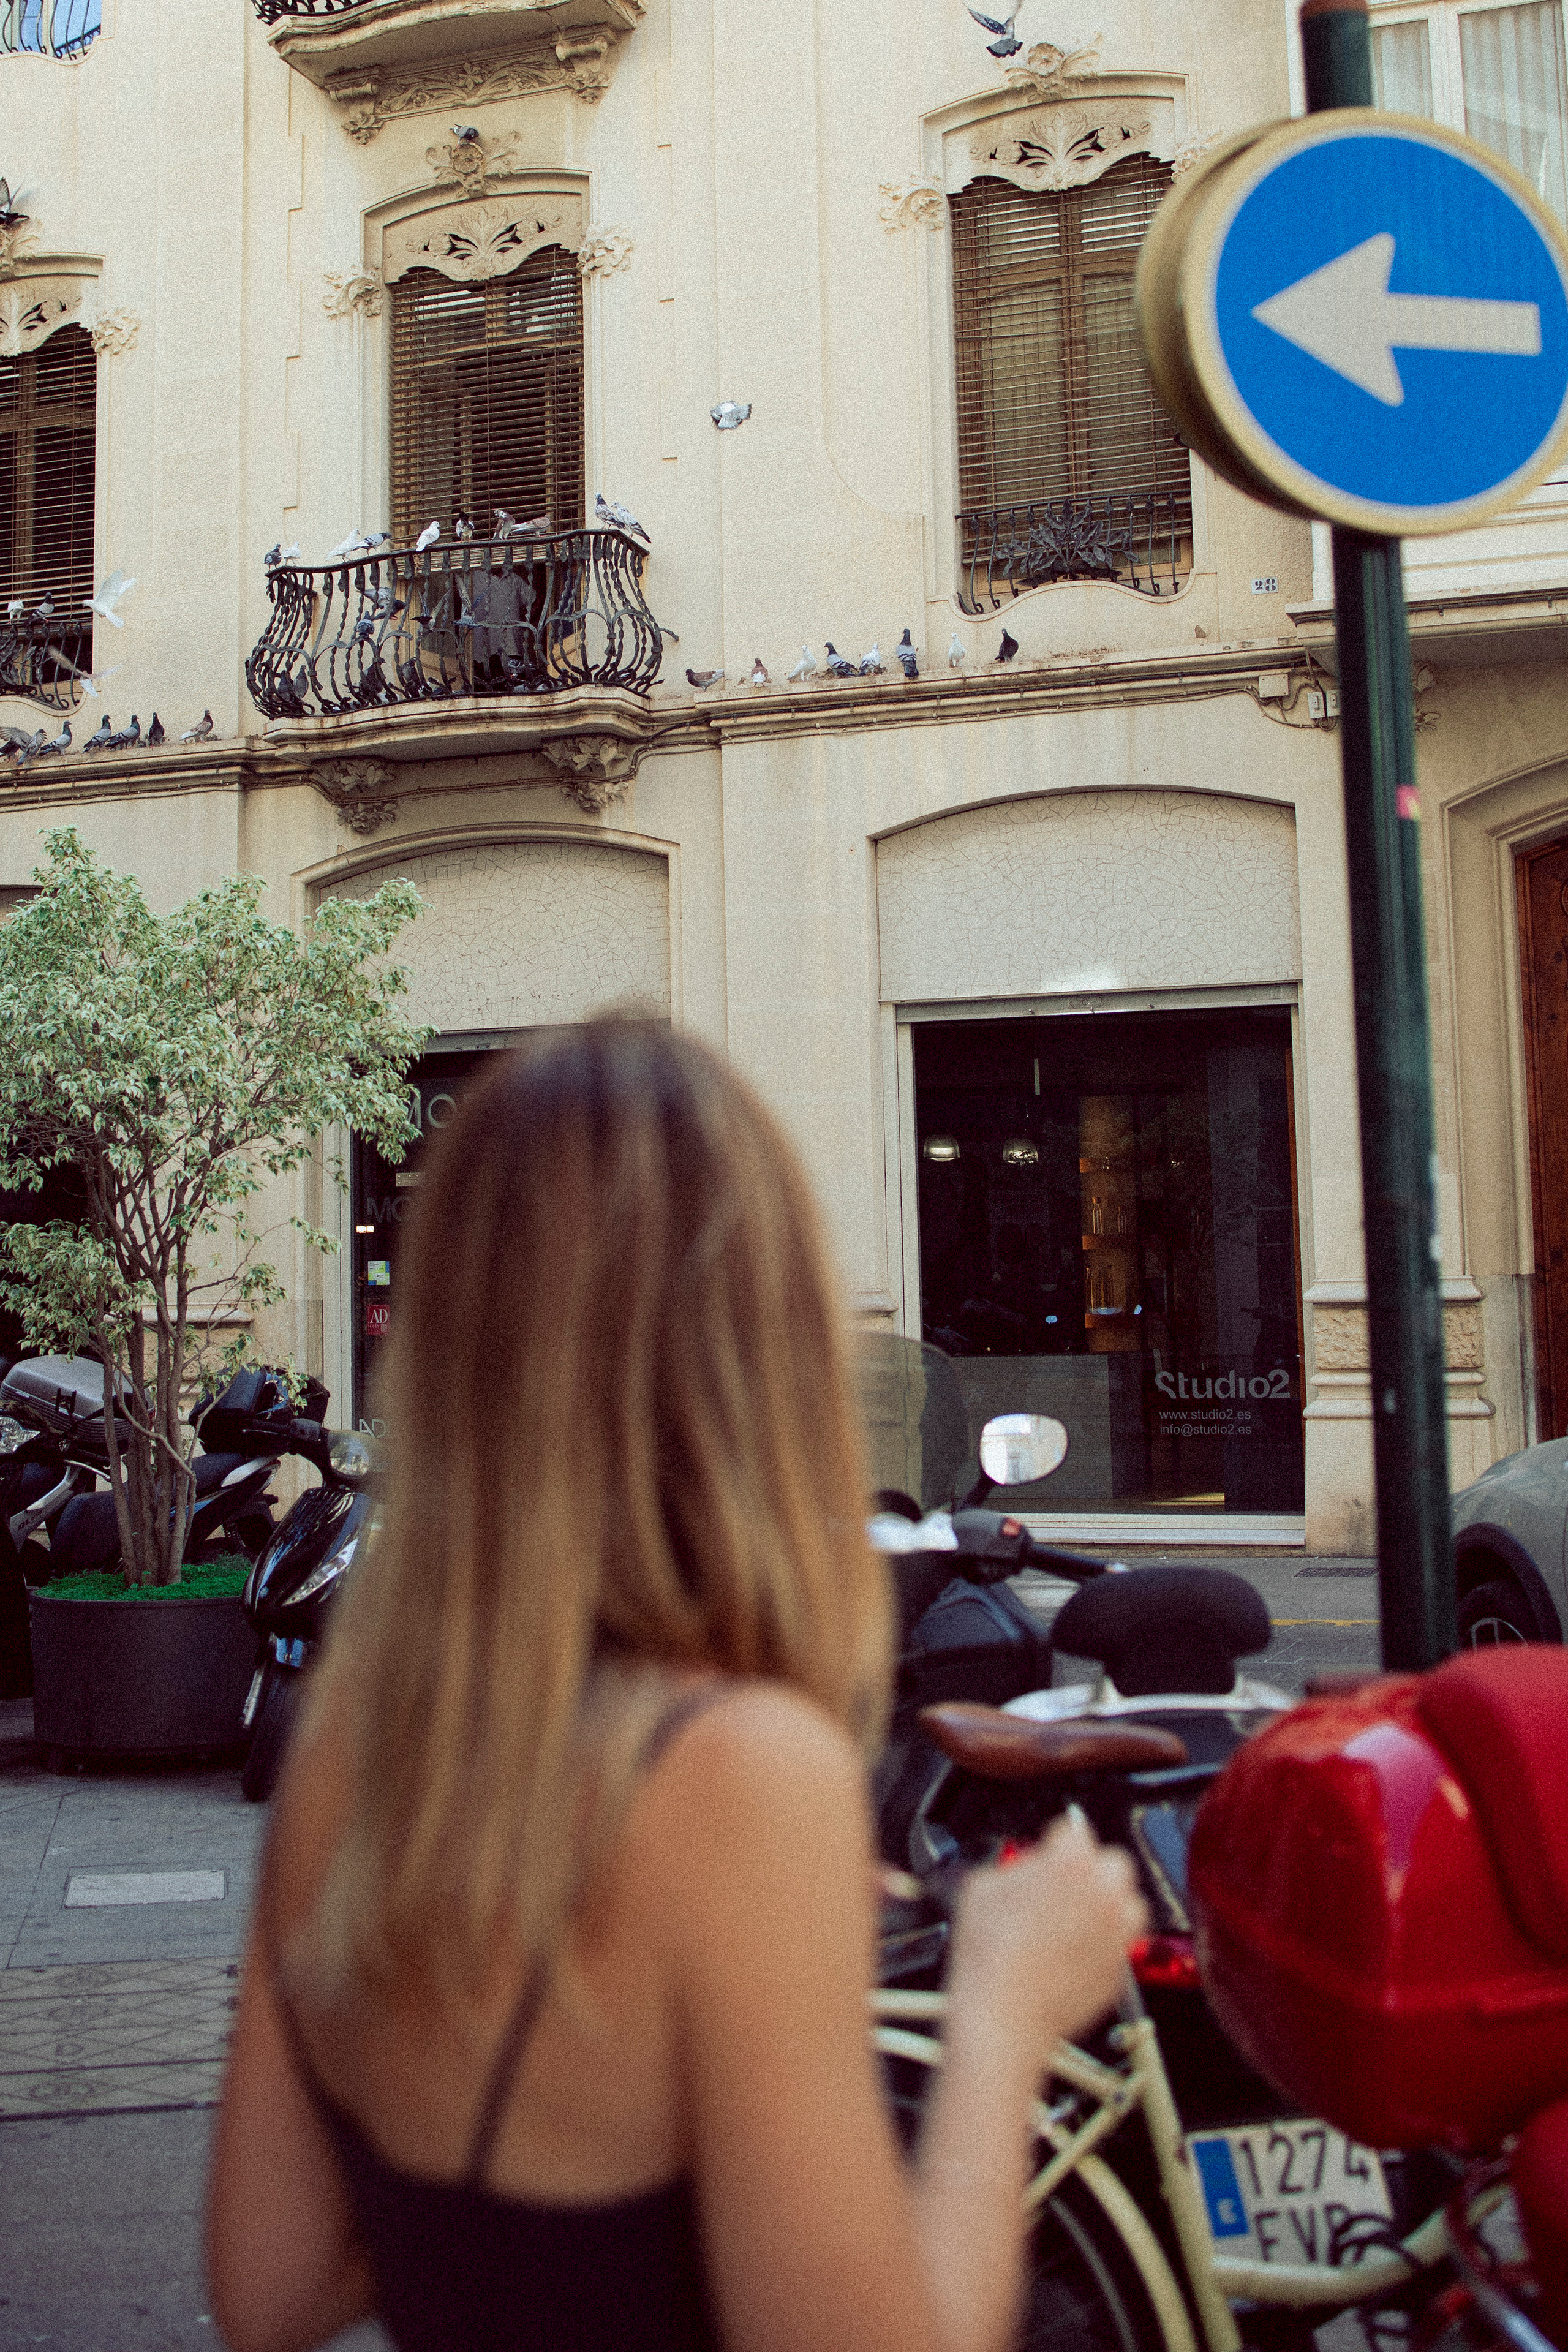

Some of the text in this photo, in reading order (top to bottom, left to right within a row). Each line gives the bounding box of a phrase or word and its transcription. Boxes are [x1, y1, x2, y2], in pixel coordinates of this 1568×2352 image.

[1255, 579, 1276, 592] 28
[370, 1308, 388, 1323] AD
[1155, 1369, 1290, 1399] Studio2
[1159, 1409, 1251, 1420] www.studio2.es
[1160, 1424, 1252, 1437] info@studio2.es
[1239, 2129, 1370, 2196] 1274
